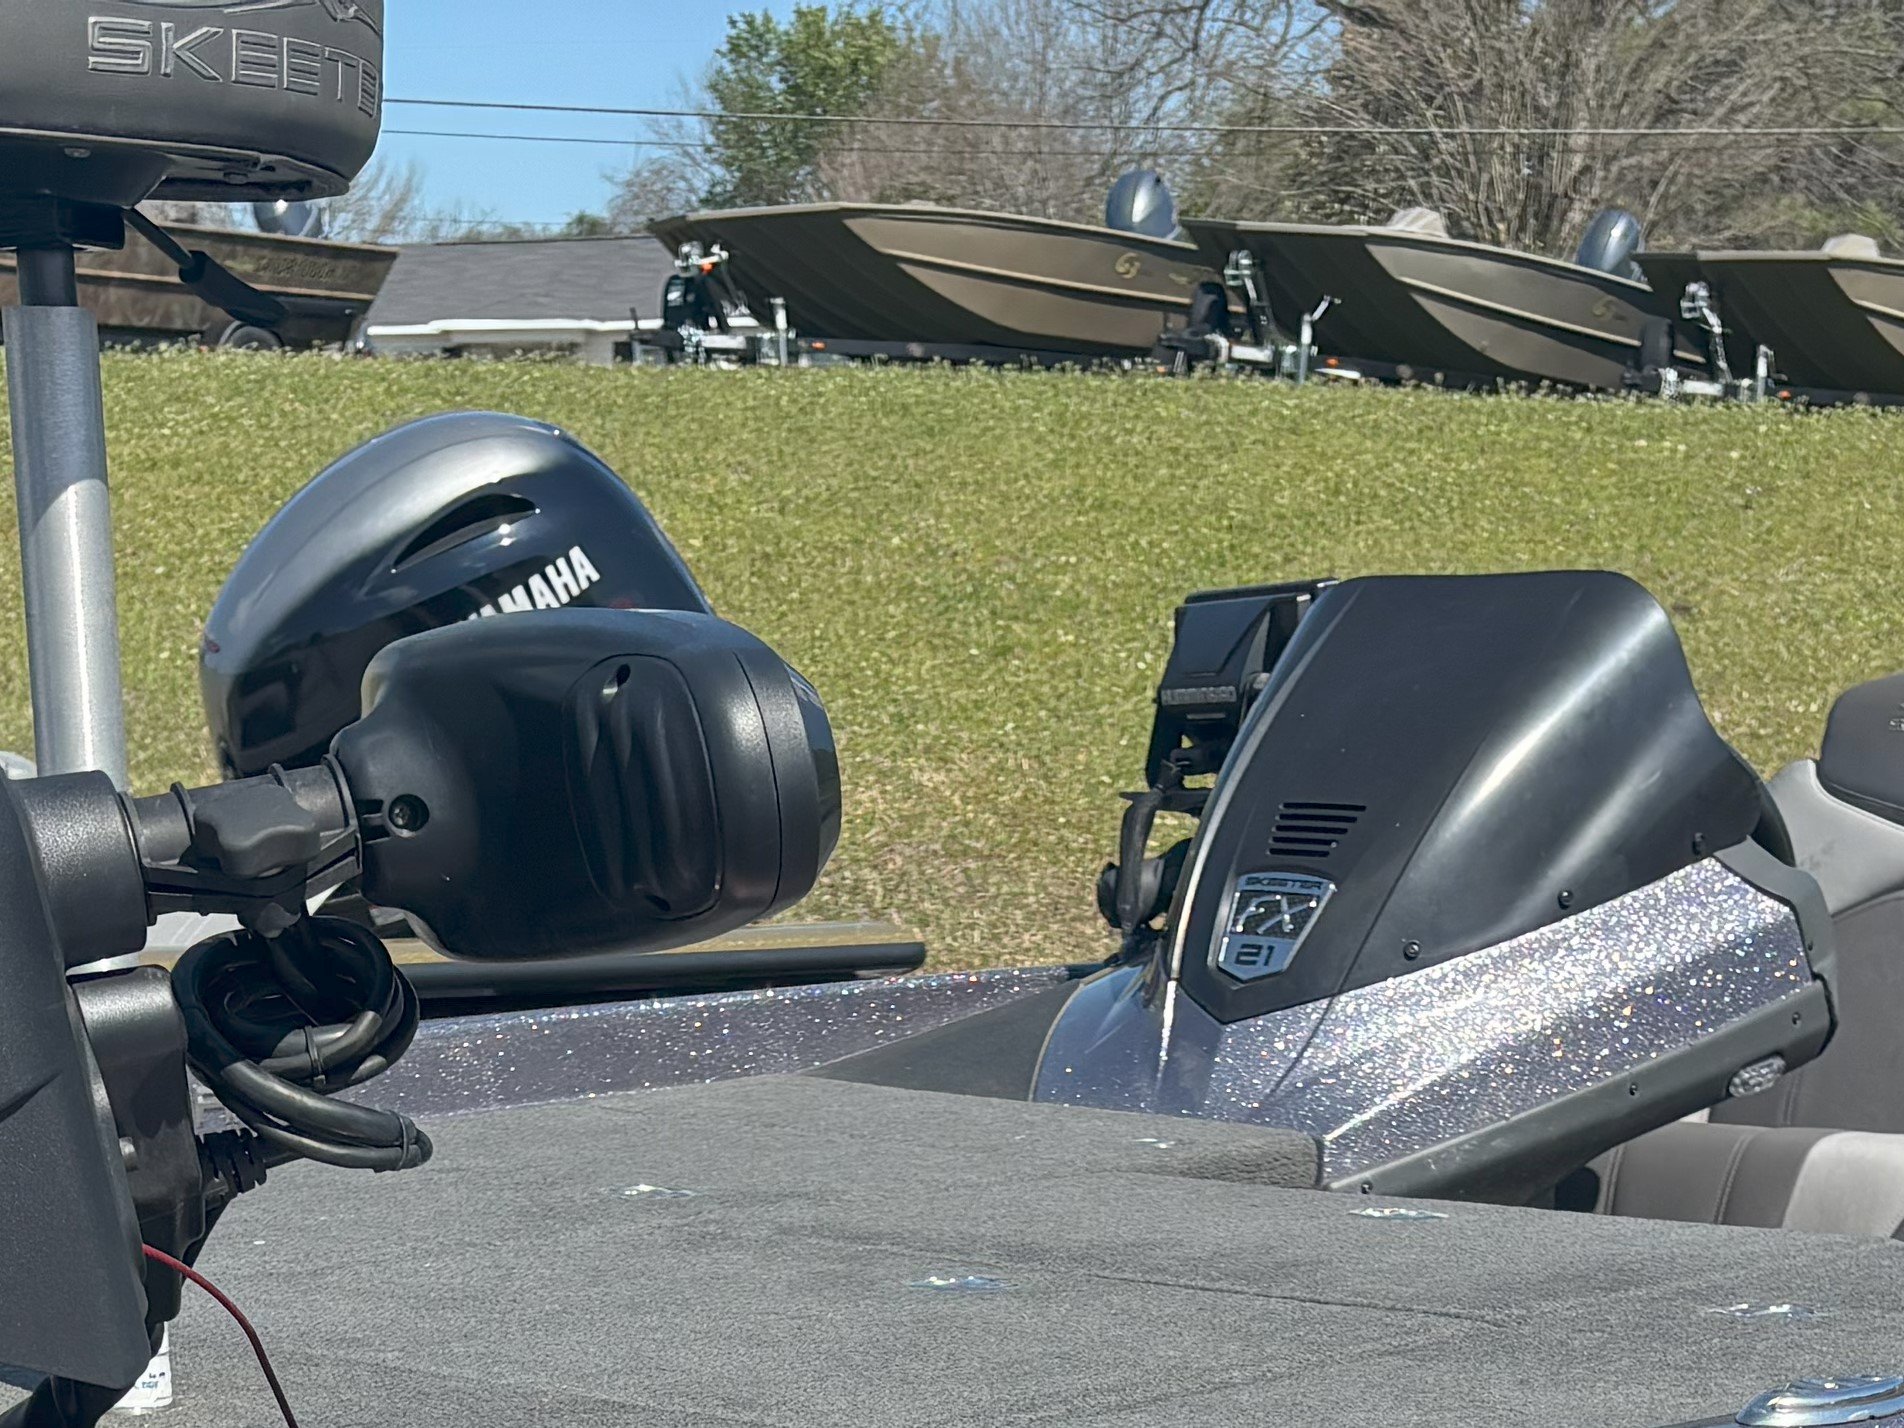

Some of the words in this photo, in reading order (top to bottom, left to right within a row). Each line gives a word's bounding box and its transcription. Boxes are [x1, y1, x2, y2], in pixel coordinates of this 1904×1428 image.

[87, 16, 380, 118] SKEETE
[469, 545, 600, 621] MAHA
[1234, 943, 1276, 967] 21
